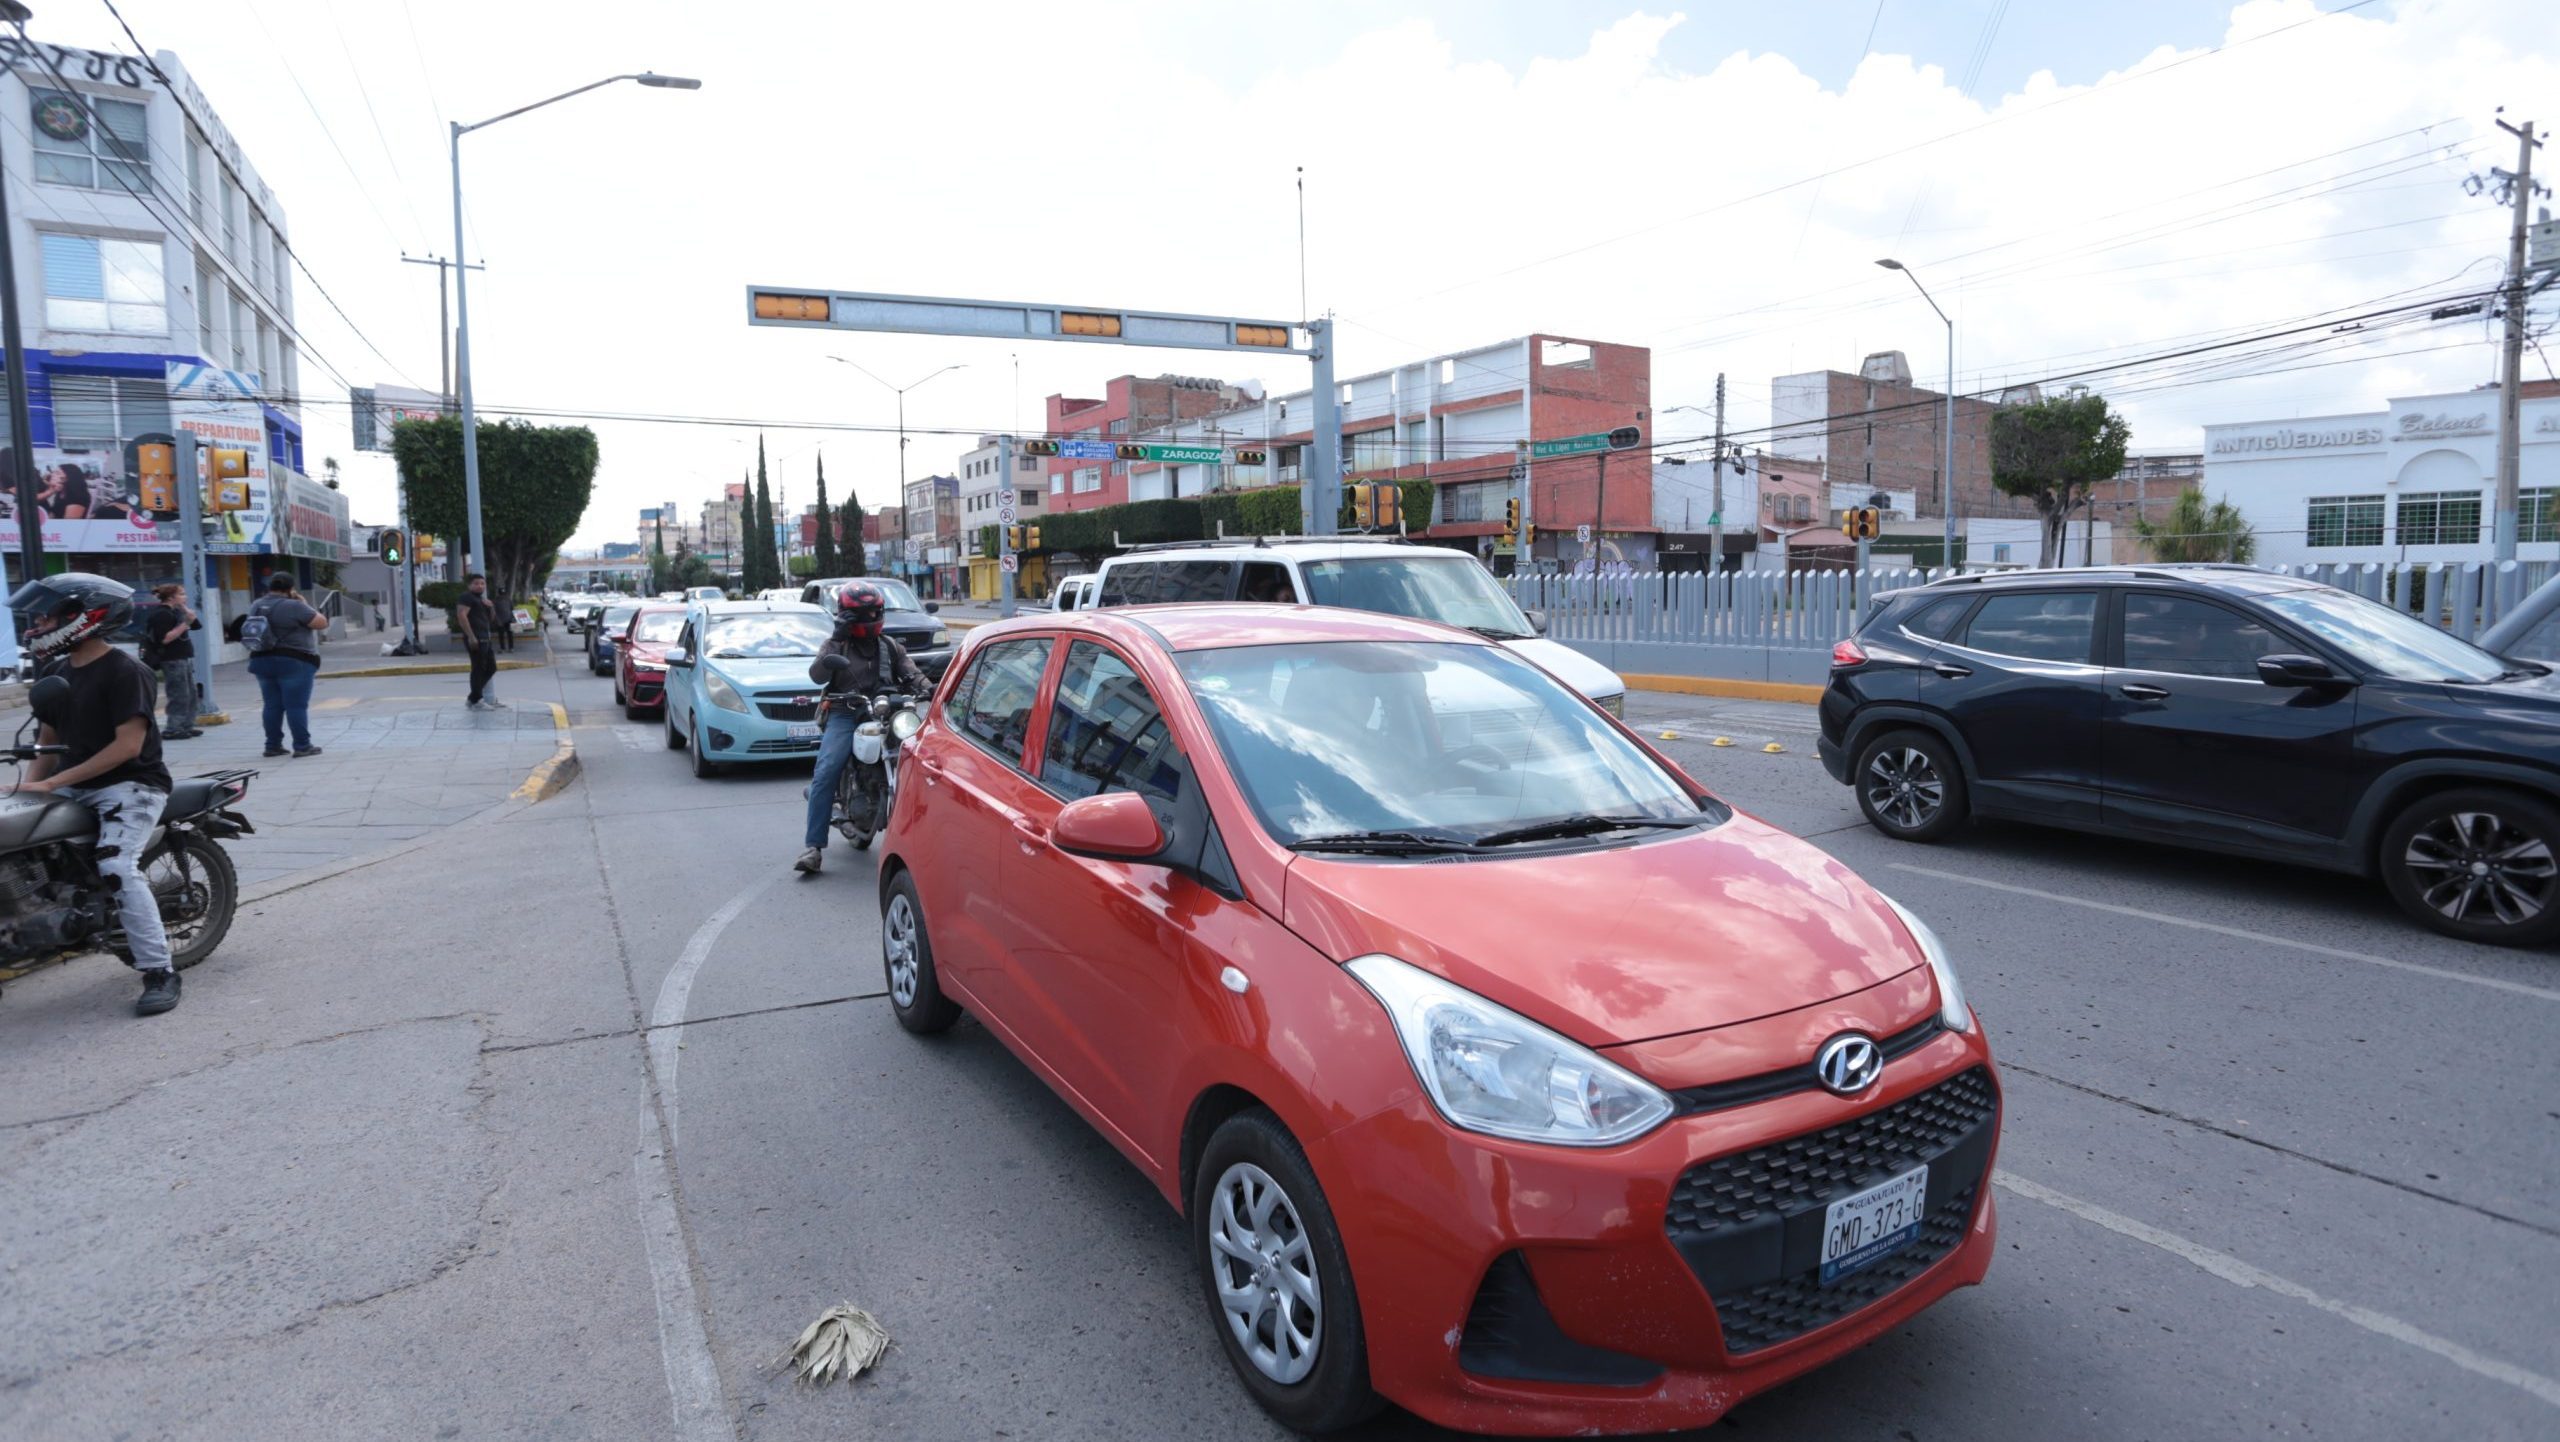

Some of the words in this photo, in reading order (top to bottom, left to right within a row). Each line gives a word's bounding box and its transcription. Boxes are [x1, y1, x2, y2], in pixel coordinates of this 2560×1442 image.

[181, 420, 261, 443] PREPARATORIA
[2211, 427, 2383, 454] ANTIGÜEDADES
[1161, 449, 1221, 460] ZARAGOZA
[116, 532, 170, 543] PESTAÑ
[1669, 543, 1685, 551] 247
[1854, 1182, 1905, 1210] GUANAJUATO
[1828, 1188, 1923, 1259] GMD-373-G
